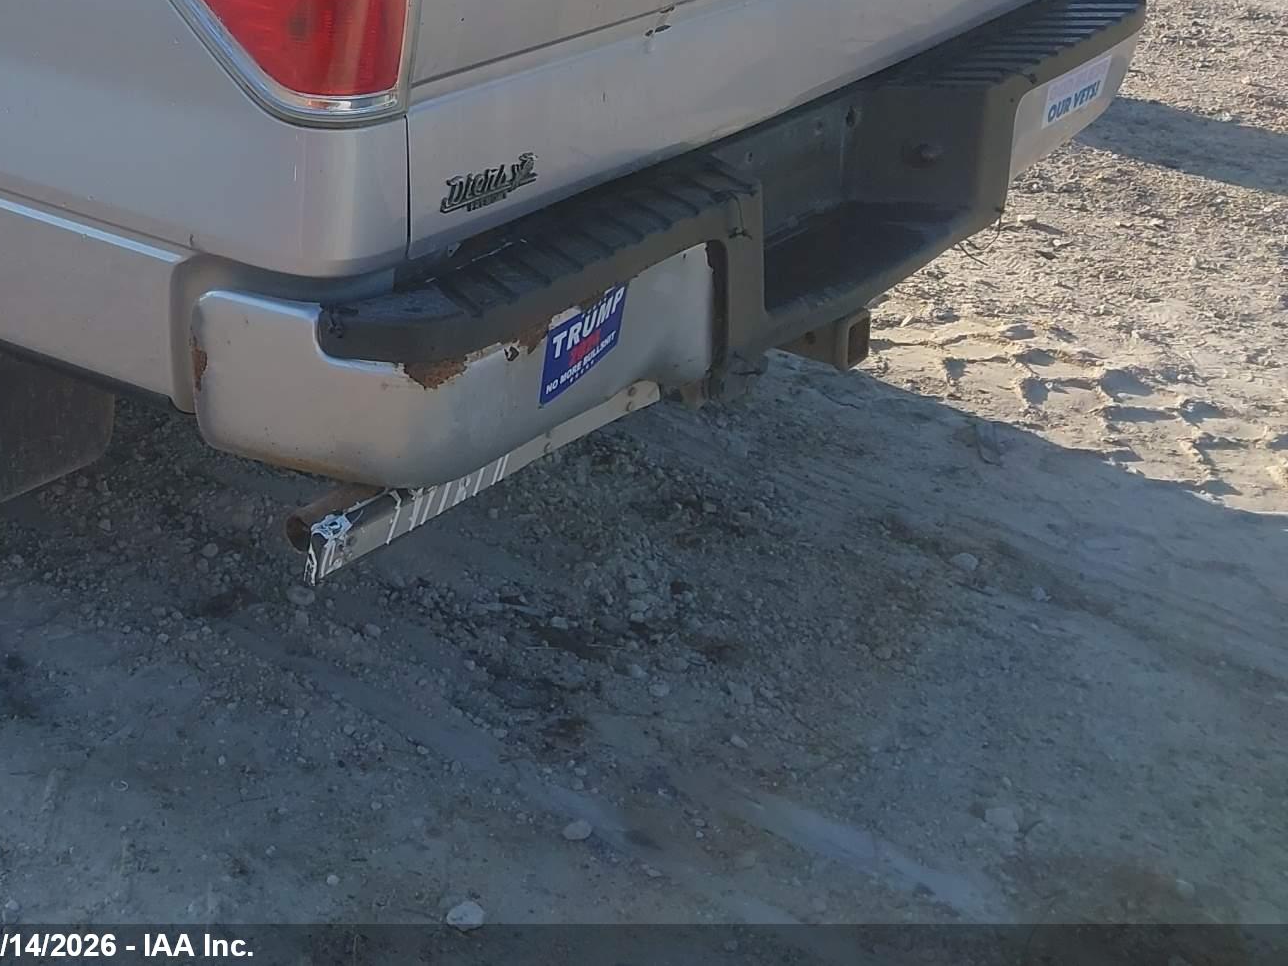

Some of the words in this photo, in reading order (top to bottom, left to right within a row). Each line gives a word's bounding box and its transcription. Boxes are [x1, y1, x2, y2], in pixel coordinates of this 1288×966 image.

[1047, 97, 1071, 122] OUR
[553, 286, 625, 359] TRUMP
[546, 379, 559, 395] NO
[560, 360, 582, 385] MORE
